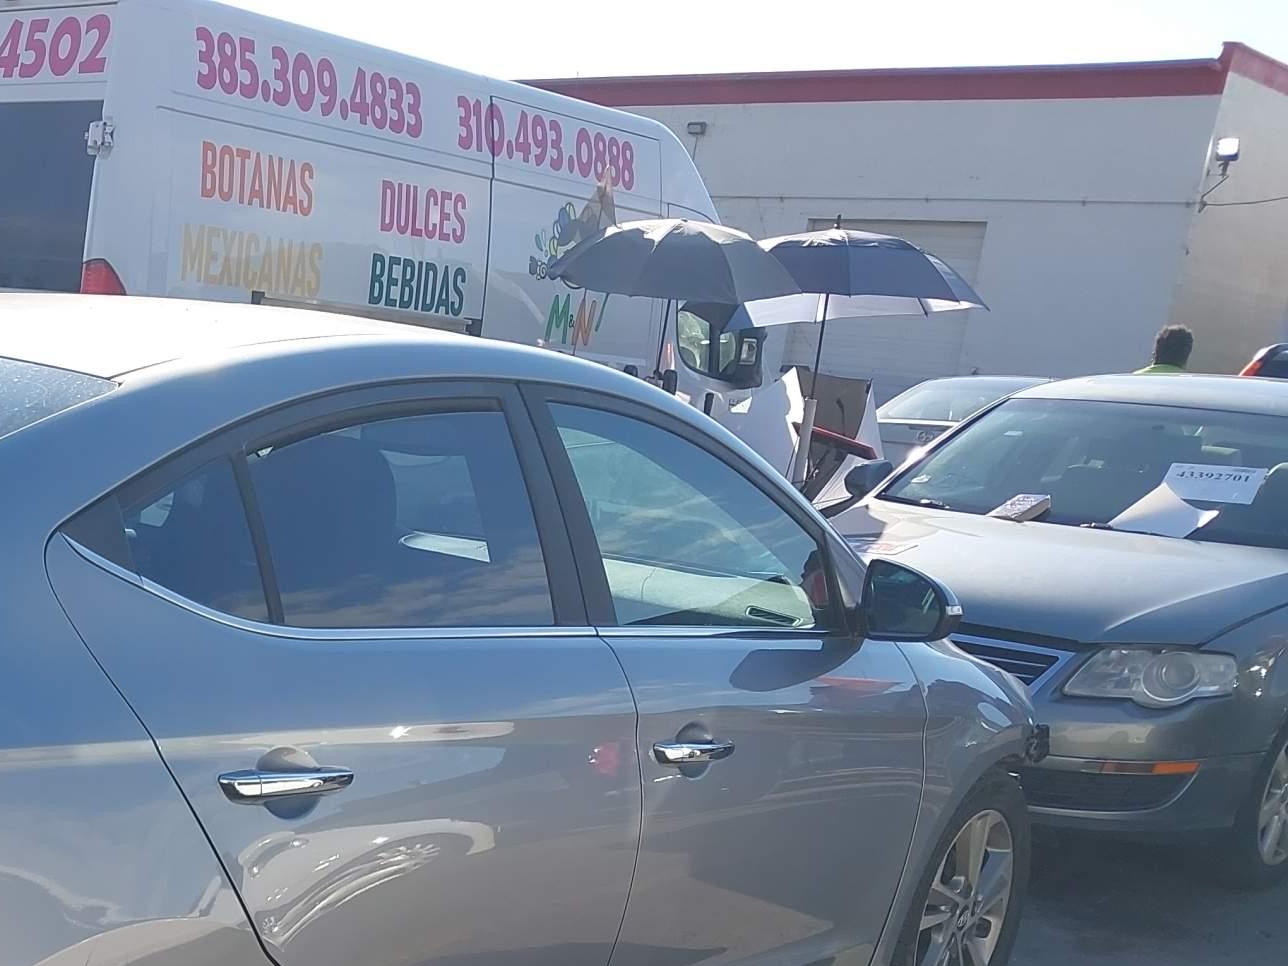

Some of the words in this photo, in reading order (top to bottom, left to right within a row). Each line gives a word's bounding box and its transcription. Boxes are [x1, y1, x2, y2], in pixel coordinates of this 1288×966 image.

[195, 26, 422, 138] 385.309.4833
[456, 95, 634, 191] 310.493.0888
[200, 140, 314, 217] BOTANAS
[379, 179, 467, 244] DULCES
[180, 222, 324, 298] MEXICANAS
[367, 252, 467, 317] BEBIDAS
[1175, 470, 1251, 483] 43392701
